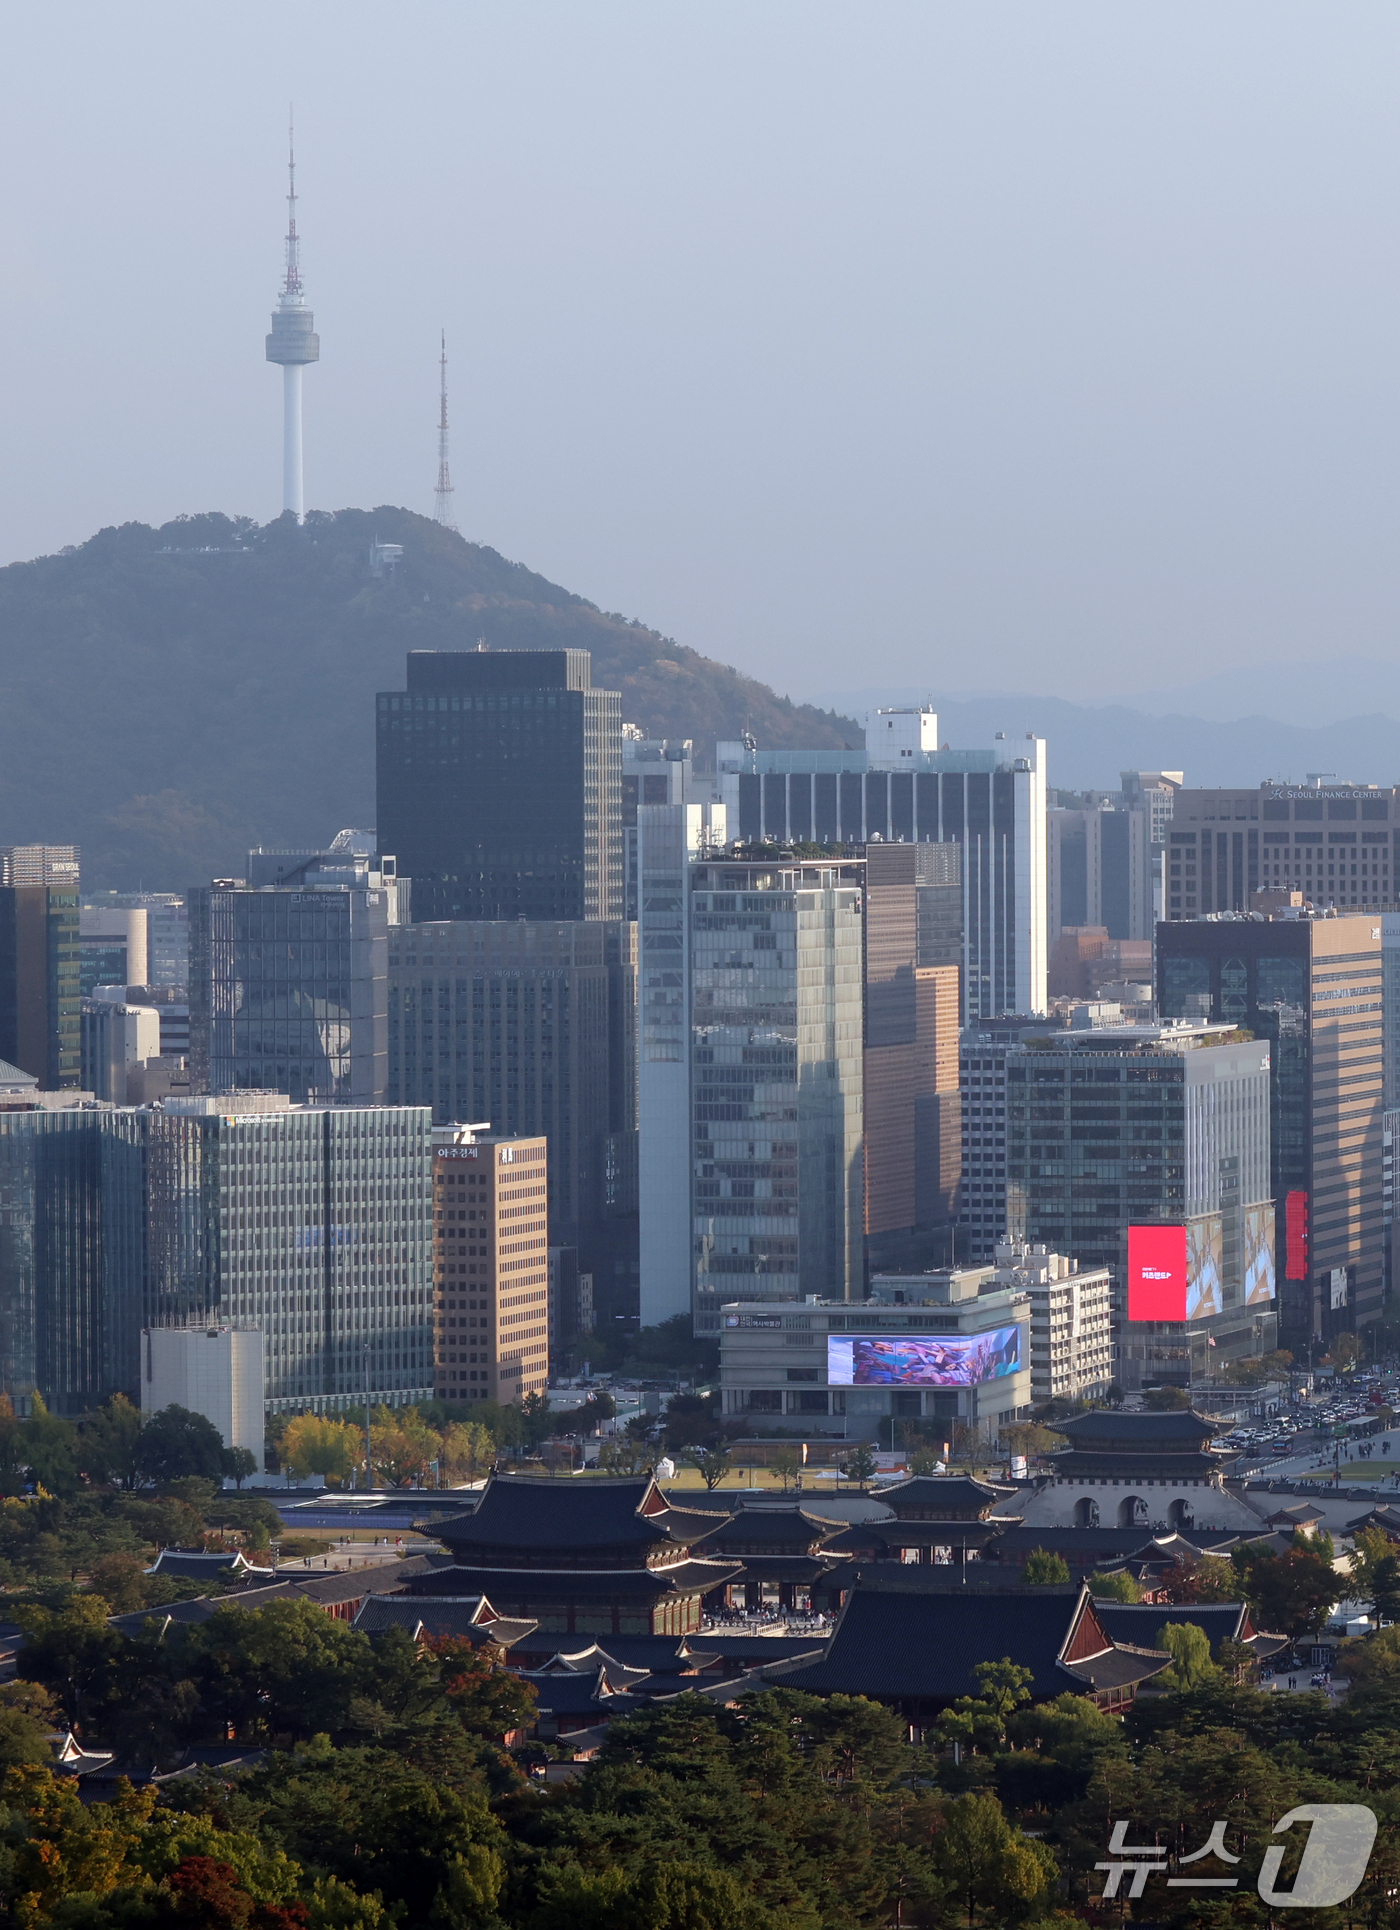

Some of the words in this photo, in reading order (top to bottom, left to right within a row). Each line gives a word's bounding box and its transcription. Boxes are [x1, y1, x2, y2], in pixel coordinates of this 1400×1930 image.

[1287, 790, 1313, 799] SEOUL
[1316, 790, 1350, 799] FINANCE
[1352, 790, 1382, 799] CENTER
[302, 894, 320, 902] LINA
[321, 894, 345, 902] Tower
[235, 1115, 262, 1125] Microsoft
[437, 1147, 478, 1159] 아주경제
